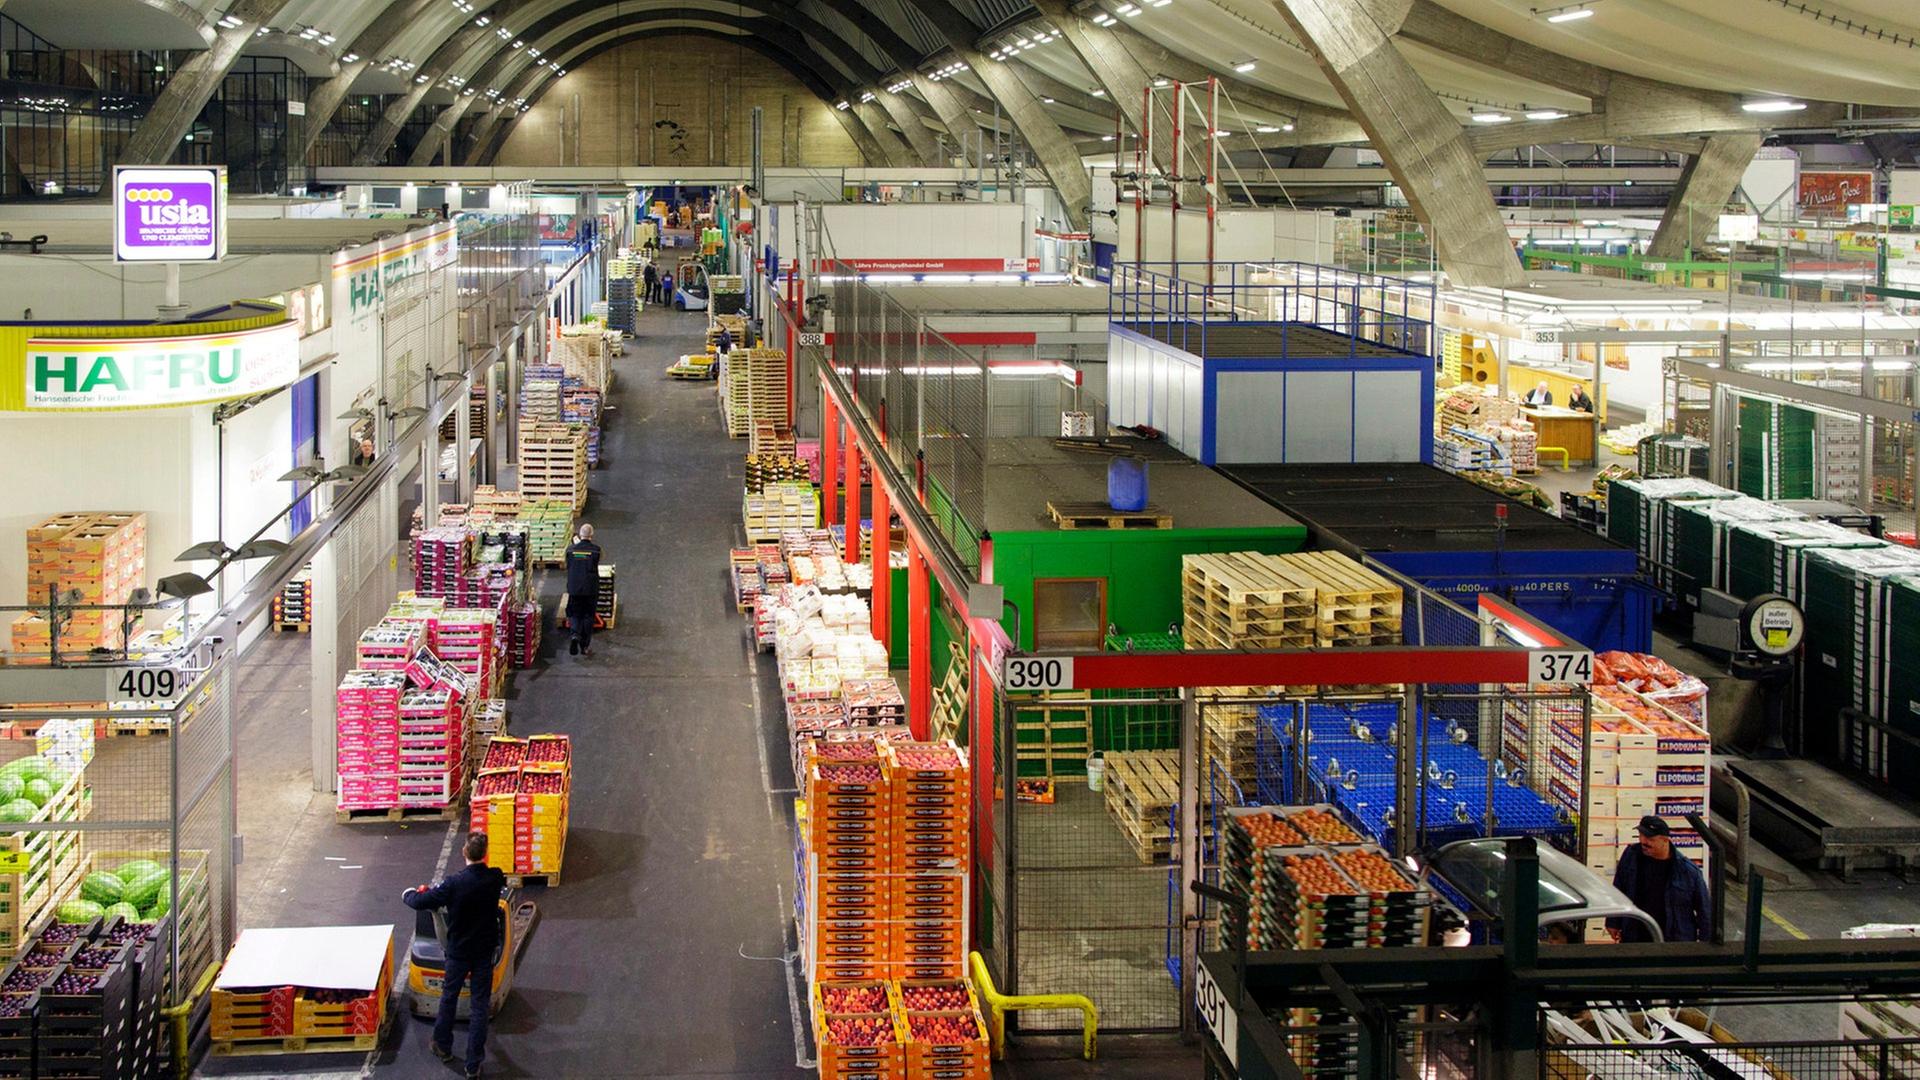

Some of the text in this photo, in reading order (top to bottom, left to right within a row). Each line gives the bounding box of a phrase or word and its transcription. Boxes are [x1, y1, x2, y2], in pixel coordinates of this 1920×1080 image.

[139, 198, 211, 225] usia
[802, 335, 820, 344] 388
[1536, 332, 1555, 343] 353
[35, 349, 241, 392] HAFRU
[1662, 358, 1677, 374] 354
[178, 654, 197, 692] 409
[1009, 660, 1062, 688] 390
[1540, 654, 1590, 681] 374
[118, 670, 175, 698] 409
[1668, 743, 1697, 751] PODIUM
[1668, 774, 1696, 783] PODIUM
[1668, 805, 1696, 814] PODIUM
[1197, 963, 1226, 1046] 391
